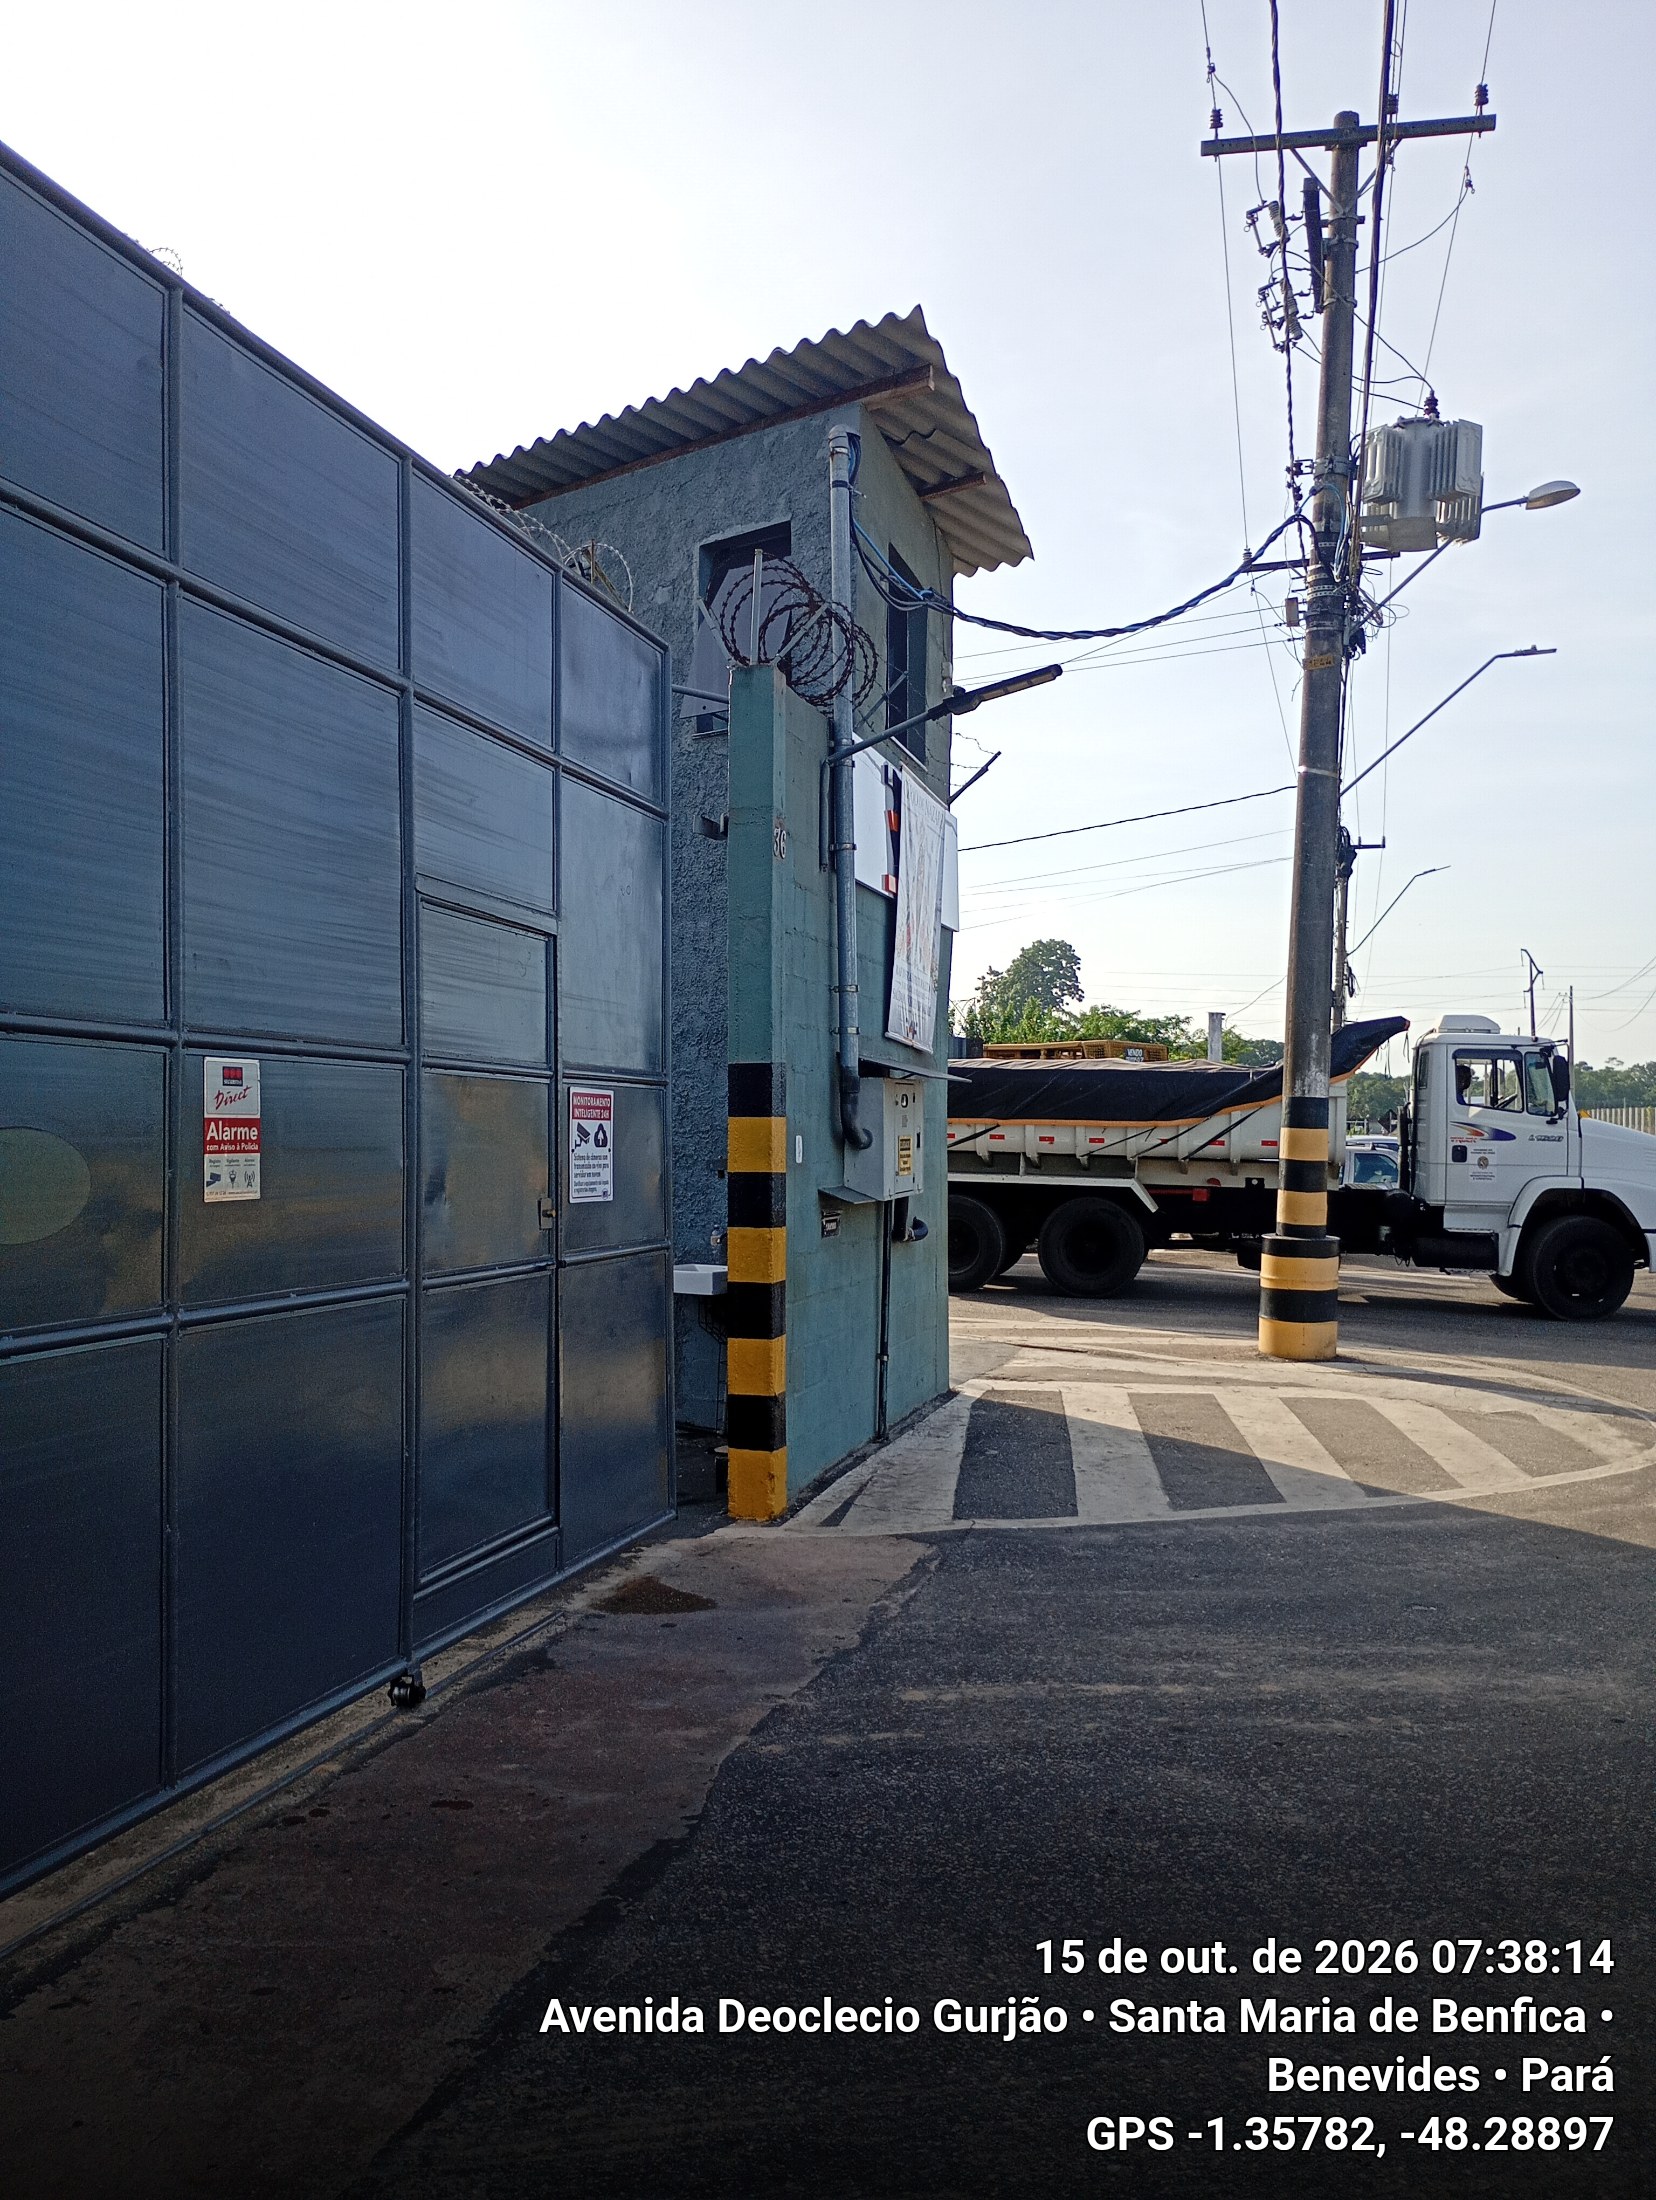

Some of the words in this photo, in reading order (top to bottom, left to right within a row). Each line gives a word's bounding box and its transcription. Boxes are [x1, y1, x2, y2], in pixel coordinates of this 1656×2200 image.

[773, 828, 787, 860] 36
[214, 1085, 252, 1111] Direct
[573, 1095, 610, 1107] MONITORAMENTO
[574, 1108, 600, 1118] INTELIGENTE
[206, 1121, 258, 1140] Alarme
[220, 1143, 235, 1151] Aviso
